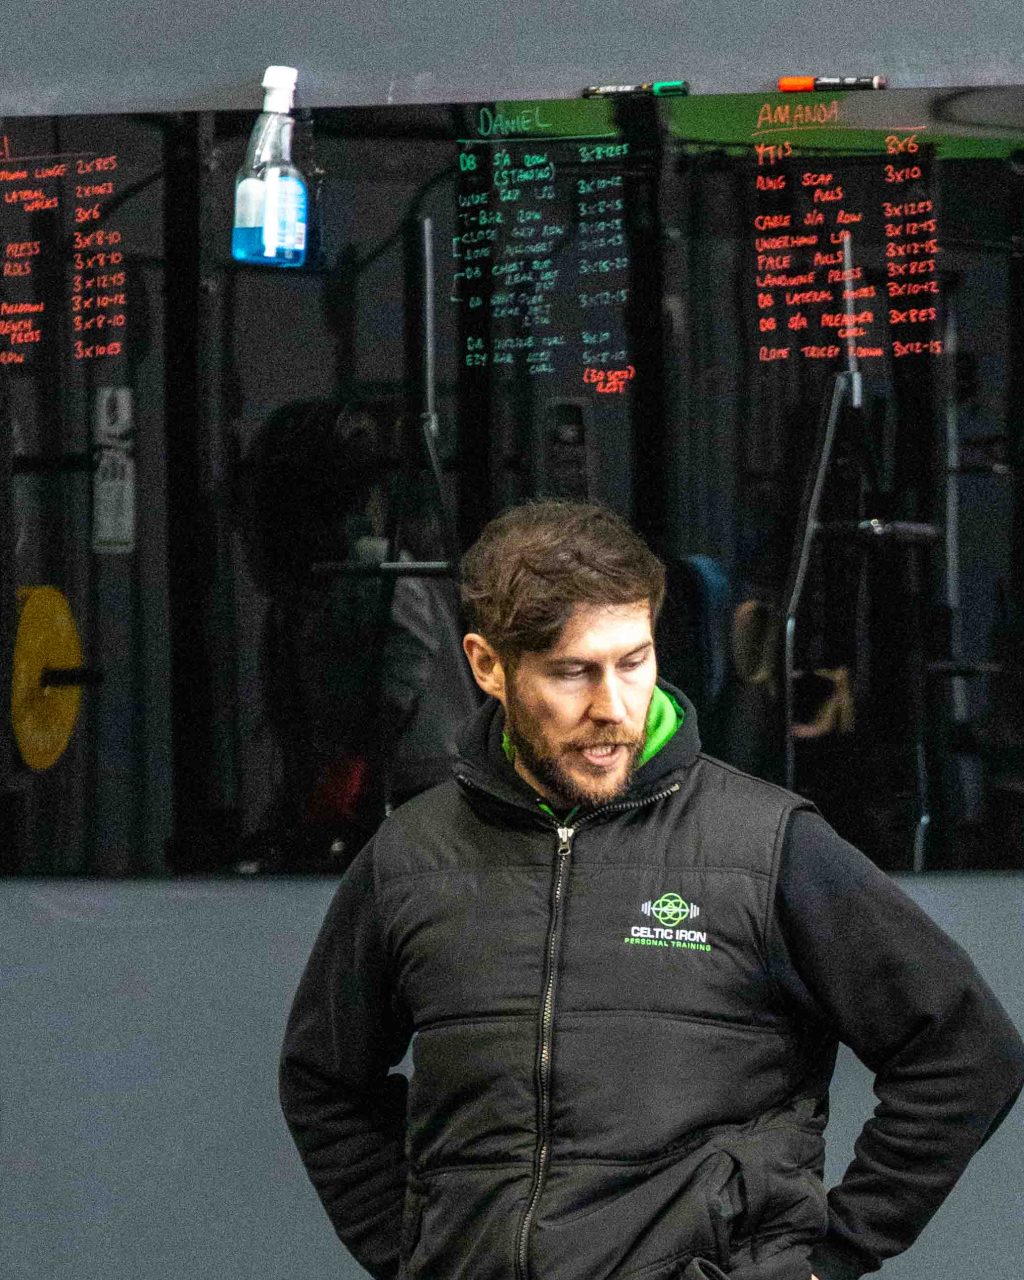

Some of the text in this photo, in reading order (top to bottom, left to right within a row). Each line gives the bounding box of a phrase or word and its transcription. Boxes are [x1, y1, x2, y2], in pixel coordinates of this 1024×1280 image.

[477, 106, 553, 137] DANIEL
[756, 101, 838, 128] AMANDA
[631, 926, 706, 942] CELTIC IRON
[624, 938, 711, 952] PERSONAL TRAINING
